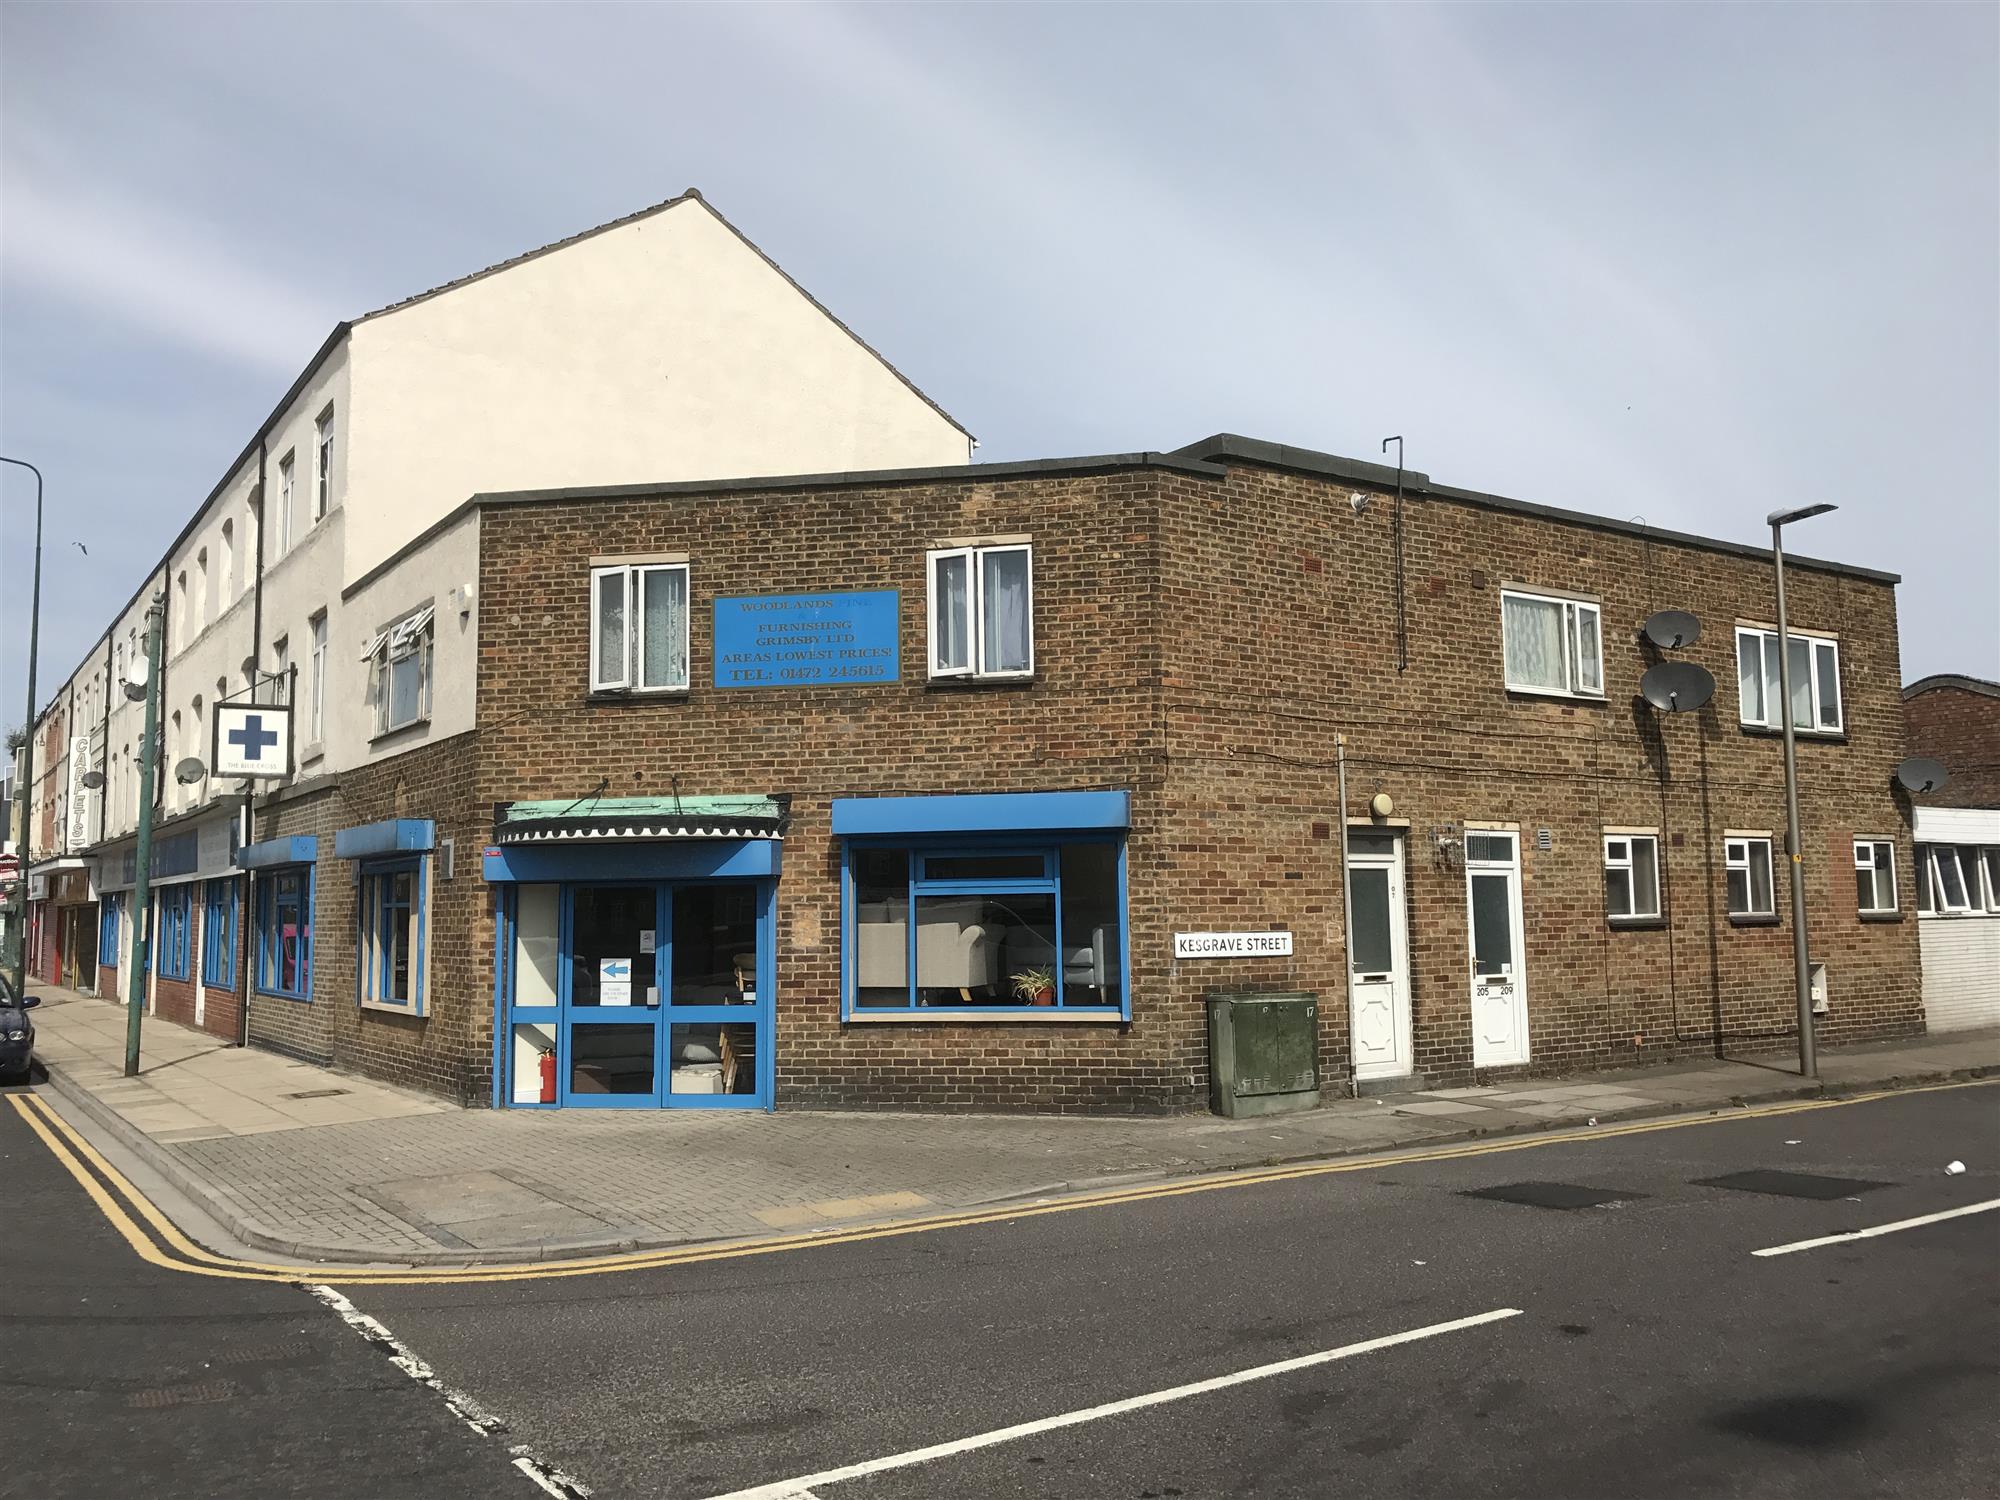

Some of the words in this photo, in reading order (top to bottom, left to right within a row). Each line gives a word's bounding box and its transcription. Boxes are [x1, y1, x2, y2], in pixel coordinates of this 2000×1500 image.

[741, 600, 833, 612] WOODLANDS
[758, 620, 852, 633] FURNISHING
[756, 635, 821, 646] GRIMSBY
[826, 634, 855, 643] LTD
[722, 652, 772, 664] AREAS
[776, 650, 833, 661] LOWEST
[839, 648, 892, 659] PRICES!
[729, 668, 773, 681] TEL:
[780, 667, 822, 680] 01472
[73, 738, 89, 838] CARPETS
[1179, 938, 1242, 952] KESGRAVE
[1247, 937, 1288, 951] STREET
[1476, 987, 1489, 997] 205
[1500, 986, 1513, 995] 209
[1306, 1007, 1314, 1018] 17
